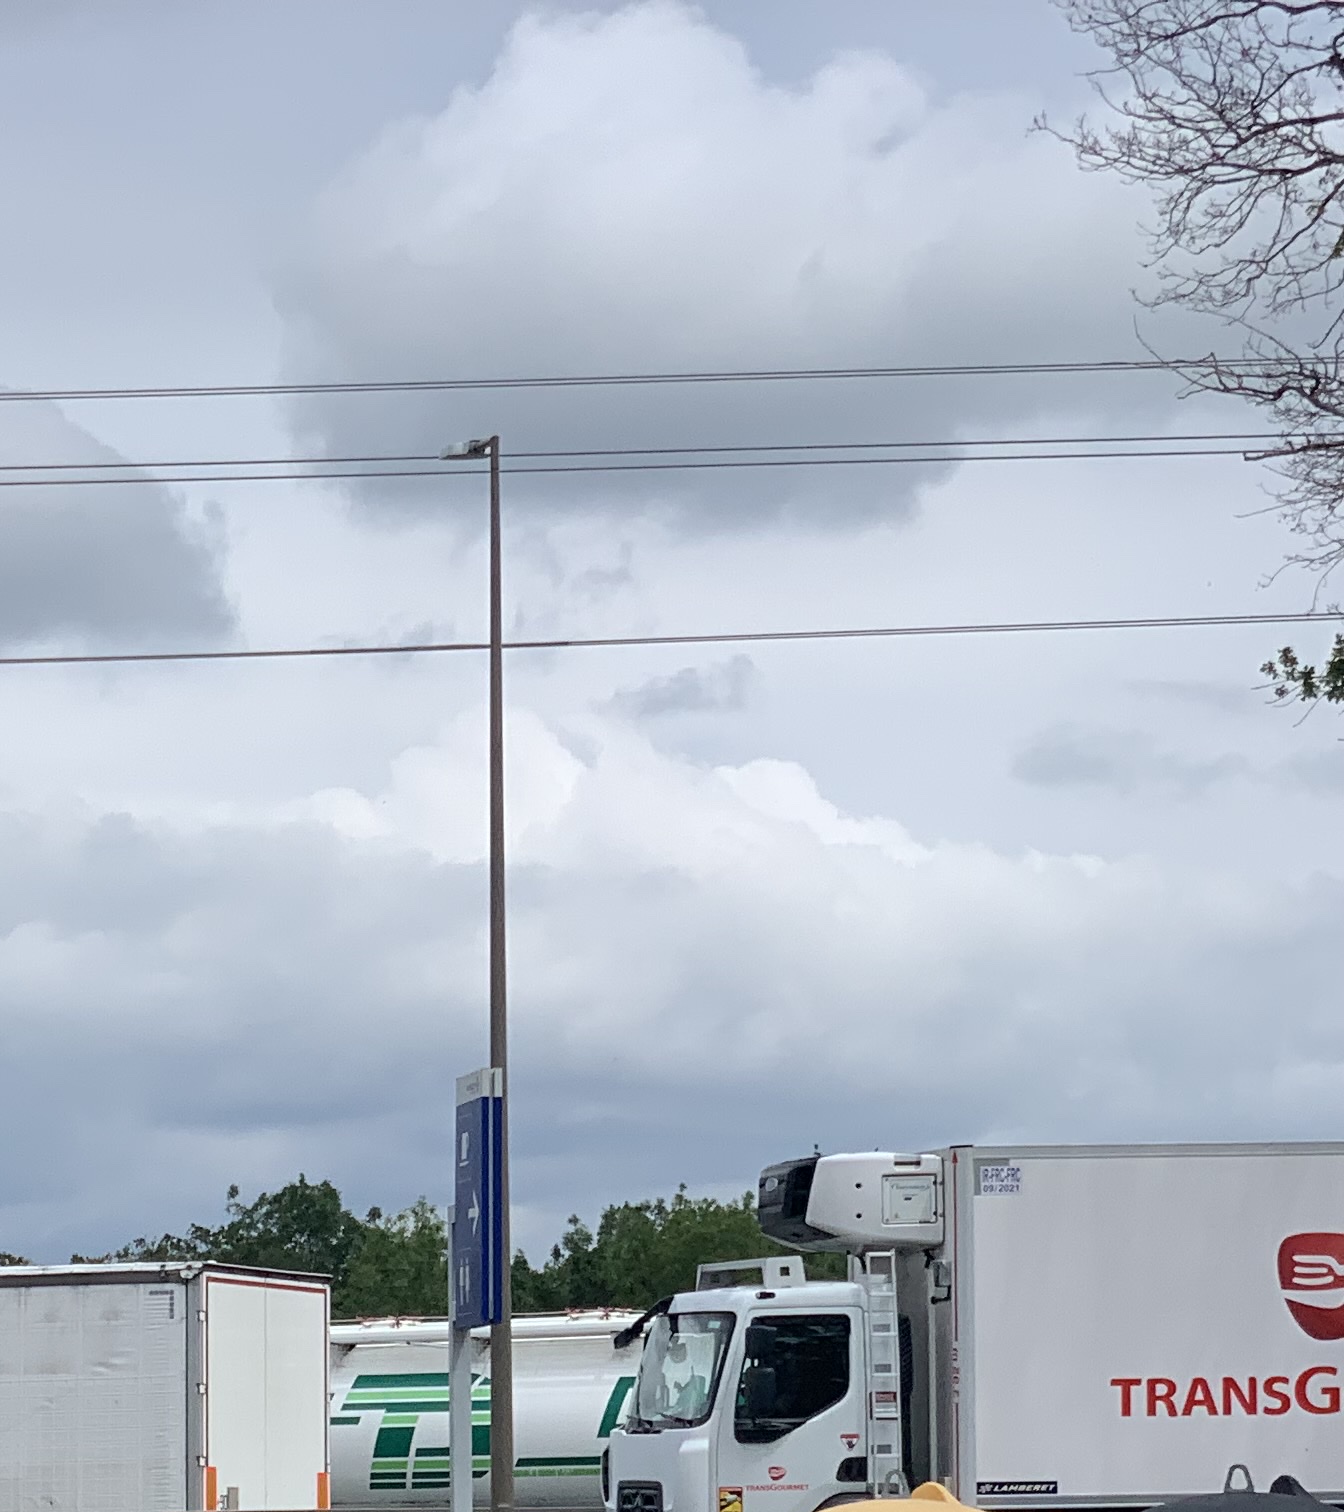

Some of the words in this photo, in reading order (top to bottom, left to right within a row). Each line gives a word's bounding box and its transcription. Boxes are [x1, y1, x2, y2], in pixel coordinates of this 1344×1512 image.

[983, 1184, 1020, 1193] 09/2021
[1110, 1365, 1341, 1417] TRANSG
[993, 1484, 1056, 1492] LAMBERET
